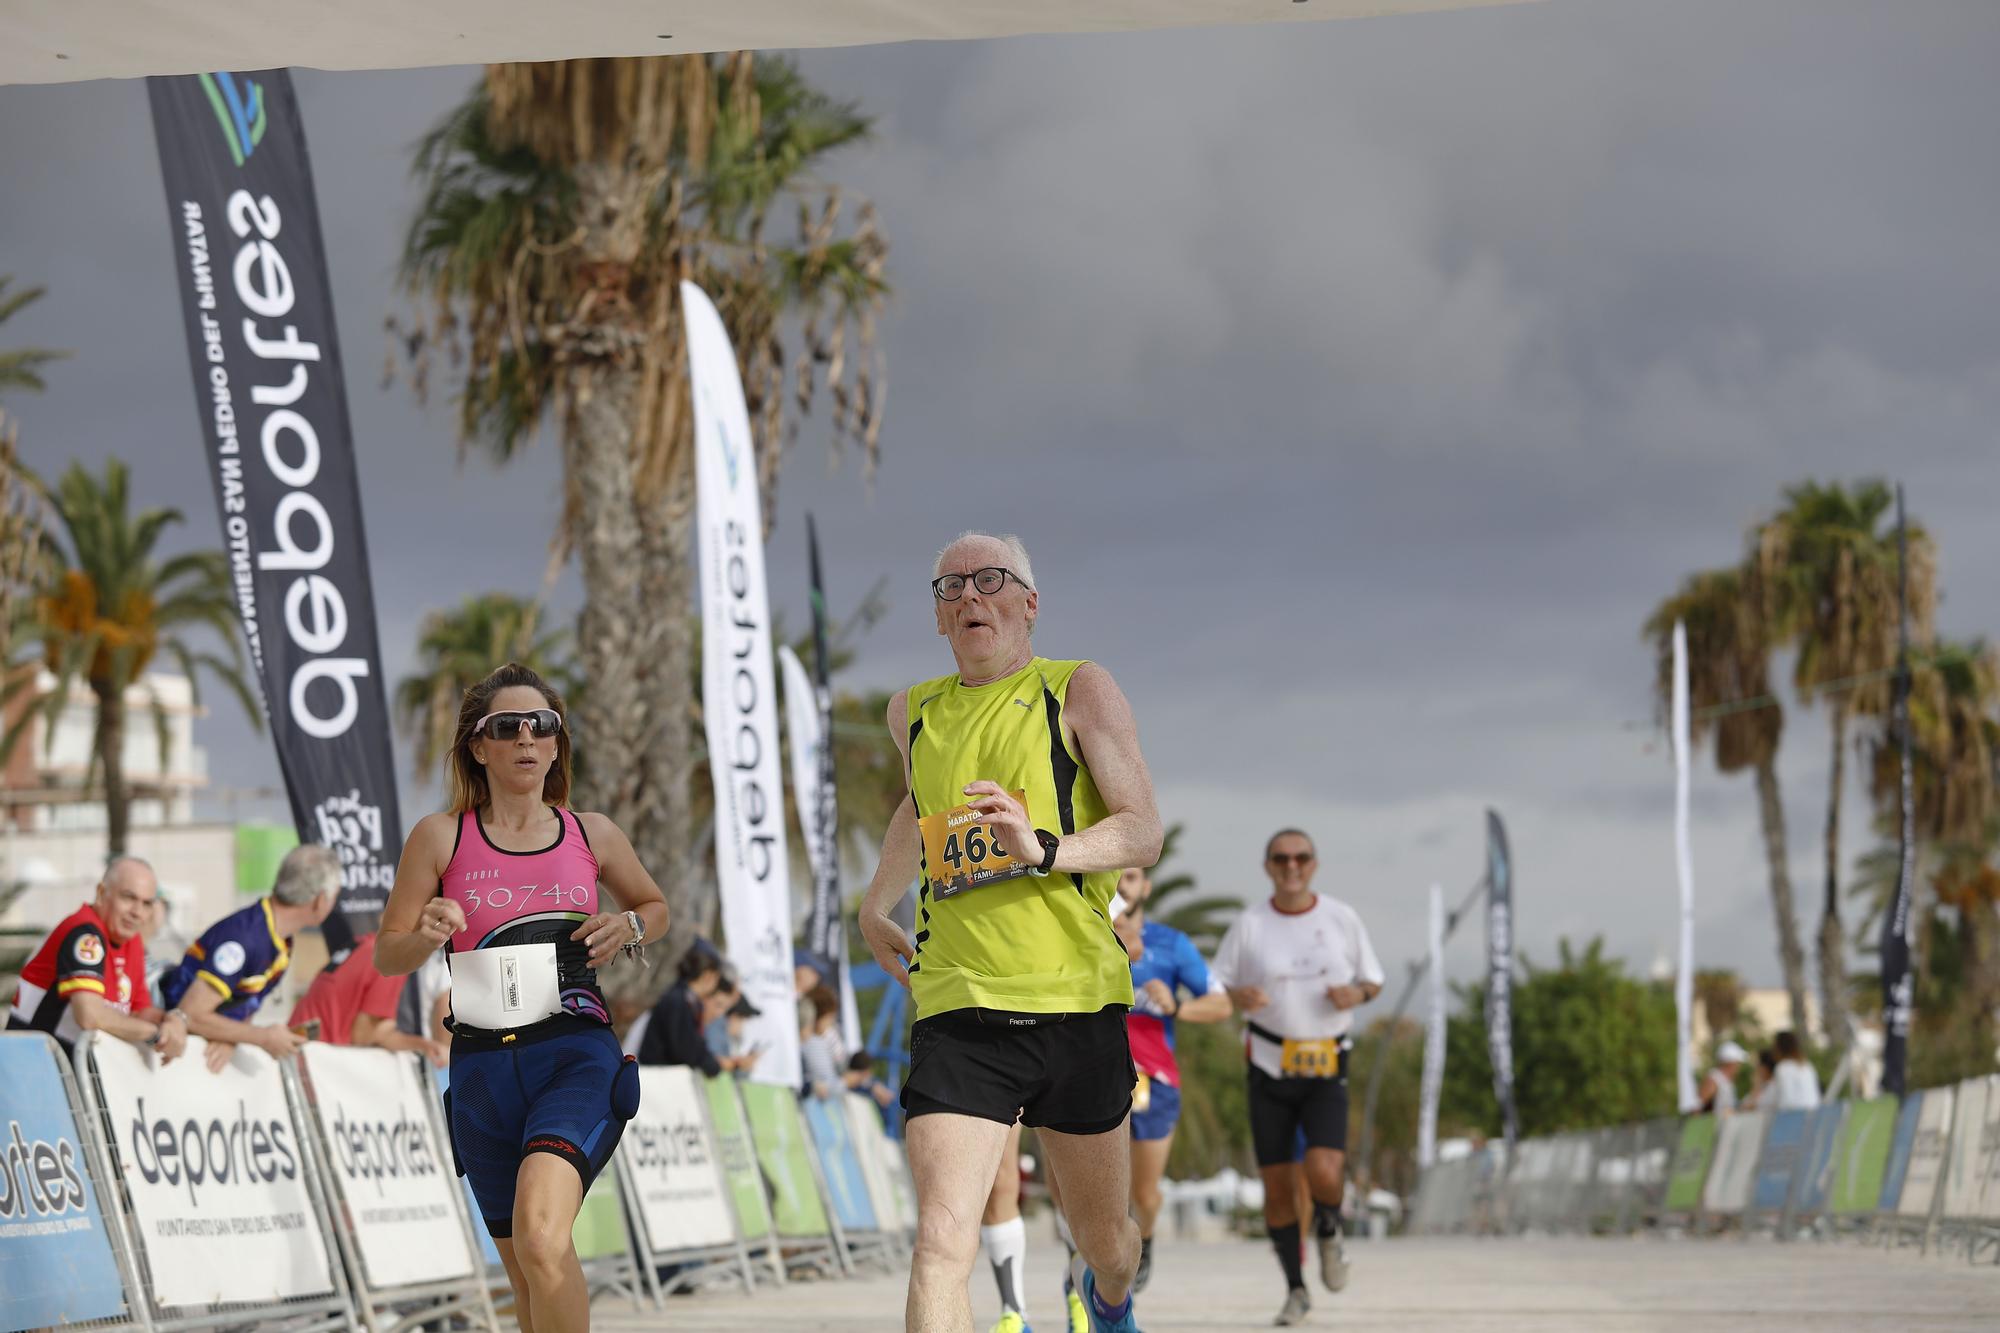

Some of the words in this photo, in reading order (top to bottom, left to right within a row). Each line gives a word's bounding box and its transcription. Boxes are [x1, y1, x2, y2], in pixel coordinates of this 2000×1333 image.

[465, 868, 500, 881] GOBIK
[973, 869, 994, 881] FAMU
[464, 883, 589, 917] 30740
[132, 1096, 297, 1208] deportes
[334, 1100, 436, 1198] deportes
